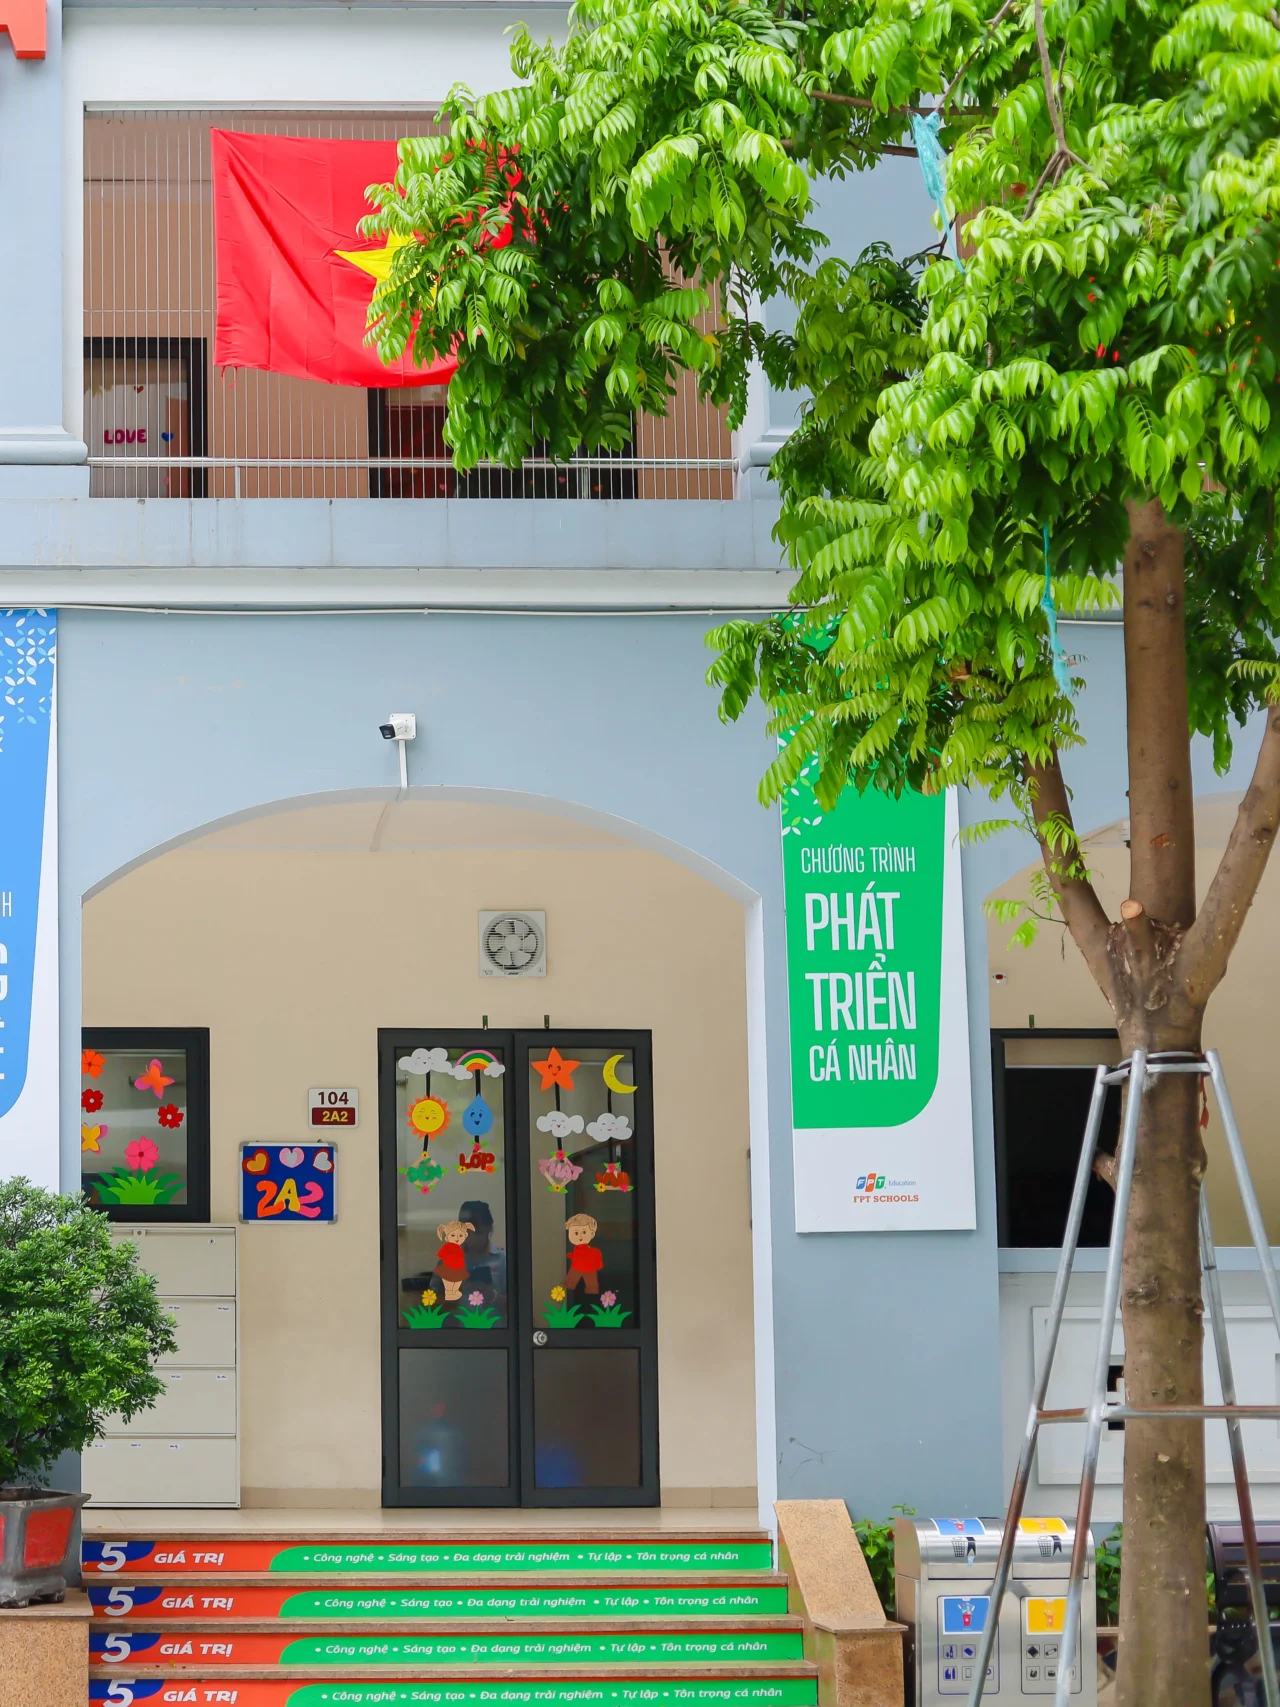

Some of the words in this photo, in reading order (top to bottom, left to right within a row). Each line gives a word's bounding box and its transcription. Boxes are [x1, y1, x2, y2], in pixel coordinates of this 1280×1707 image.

[104, 429, 147, 444] LOVE
[801, 844, 865, 873] CHƯƠNG
[870, 843, 916, 873] TRÌNH
[805, 881, 900, 951] PHÁT
[805, 953, 917, 1031] TRIỂN
[809, 1038, 841, 1082] CÁ
[848, 1037, 917, 1081] NHÂN
[318, 1091, 349, 1105] 104
[322, 1111, 349, 1122] 2A2
[856, 1173, 886, 1192] FPT
[256, 1178, 324, 1218] 2A2
[853, 1195, 871, 1203] FPT
[873, 1195, 919, 1203] SCHOOLS
[97, 1542, 128, 1572] 5
[154, 1550, 186, 1564] GIÁ
[192, 1552, 224, 1566] TRỊ
[314, 1554, 342, 1564] Công
[346, 1554, 374, 1564] nghệ
[388, 1553, 417, 1564] Sáng
[420, 1554, 439, 1563] tạo
[454, 1553, 469, 1561] Đa
[473, 1553, 501, 1563] dạng
[505, 1552, 525, 1561] trải
[528, 1552, 570, 1562] nghiệm
[588, 1552, 602, 1561] Tự
[604, 1552, 622, 1562] lập
[637, 1552, 656, 1560] Tôn
[660, 1553, 690, 1562] trọng
[694, 1552, 706, 1560] cá
[710, 1552, 738, 1560] nhân
[104, 1587, 135, 1616] 5
[162, 1594, 194, 1608] GIÁ
[201, 1598, 233, 1611] TRỊ
[324, 1599, 354, 1609] Công
[357, 1598, 386, 1609] nghệ
[400, 1598, 430, 1608] Sáng
[434, 1600, 452, 1608] tạo
[467, 1598, 483, 1606] Đa
[487, 1598, 516, 1608] dạng
[520, 1598, 540, 1606] trải
[543, 1598, 586, 1608] nghiệm
[604, 1597, 619, 1606] Tự
[621, 1597, 639, 1607] lập
[654, 1597, 674, 1605] Tôn
[678, 1598, 708, 1606] trọng
[712, 1597, 726, 1605] cá
[730, 1596, 758, 1604] nhân
[101, 1633, 132, 1662] 5
[160, 1641, 192, 1655] GIÁ
[200, 1644, 232, 1657] TRỊ
[326, 1645, 355, 1655] Công
[359, 1645, 388, 1655] nghệ
[403, 1644, 432, 1654] Sáng
[436, 1646, 456, 1654] tạo
[471, 1644, 487, 1653] Đa
[491, 1644, 520, 1654] dạng
[524, 1644, 544, 1652] trải
[548, 1644, 591, 1654] nghiệm
[610, 1644, 625, 1653] Tự
[628, 1643, 646, 1653] lập
[661, 1643, 681, 1651] Tôn
[685, 1644, 716, 1652] trọng
[738, 1642, 767, 1650] nhân
[103, 1679, 136, 1707] 5
[164, 1688, 196, 1702] GIÁ
[204, 1691, 237, 1704] TRỊ
[332, 1692, 362, 1702] Công
[366, 1692, 396, 1702] nghệ
[411, 1691, 441, 1702] Sáng
[445, 1693, 464, 1701] tạo
